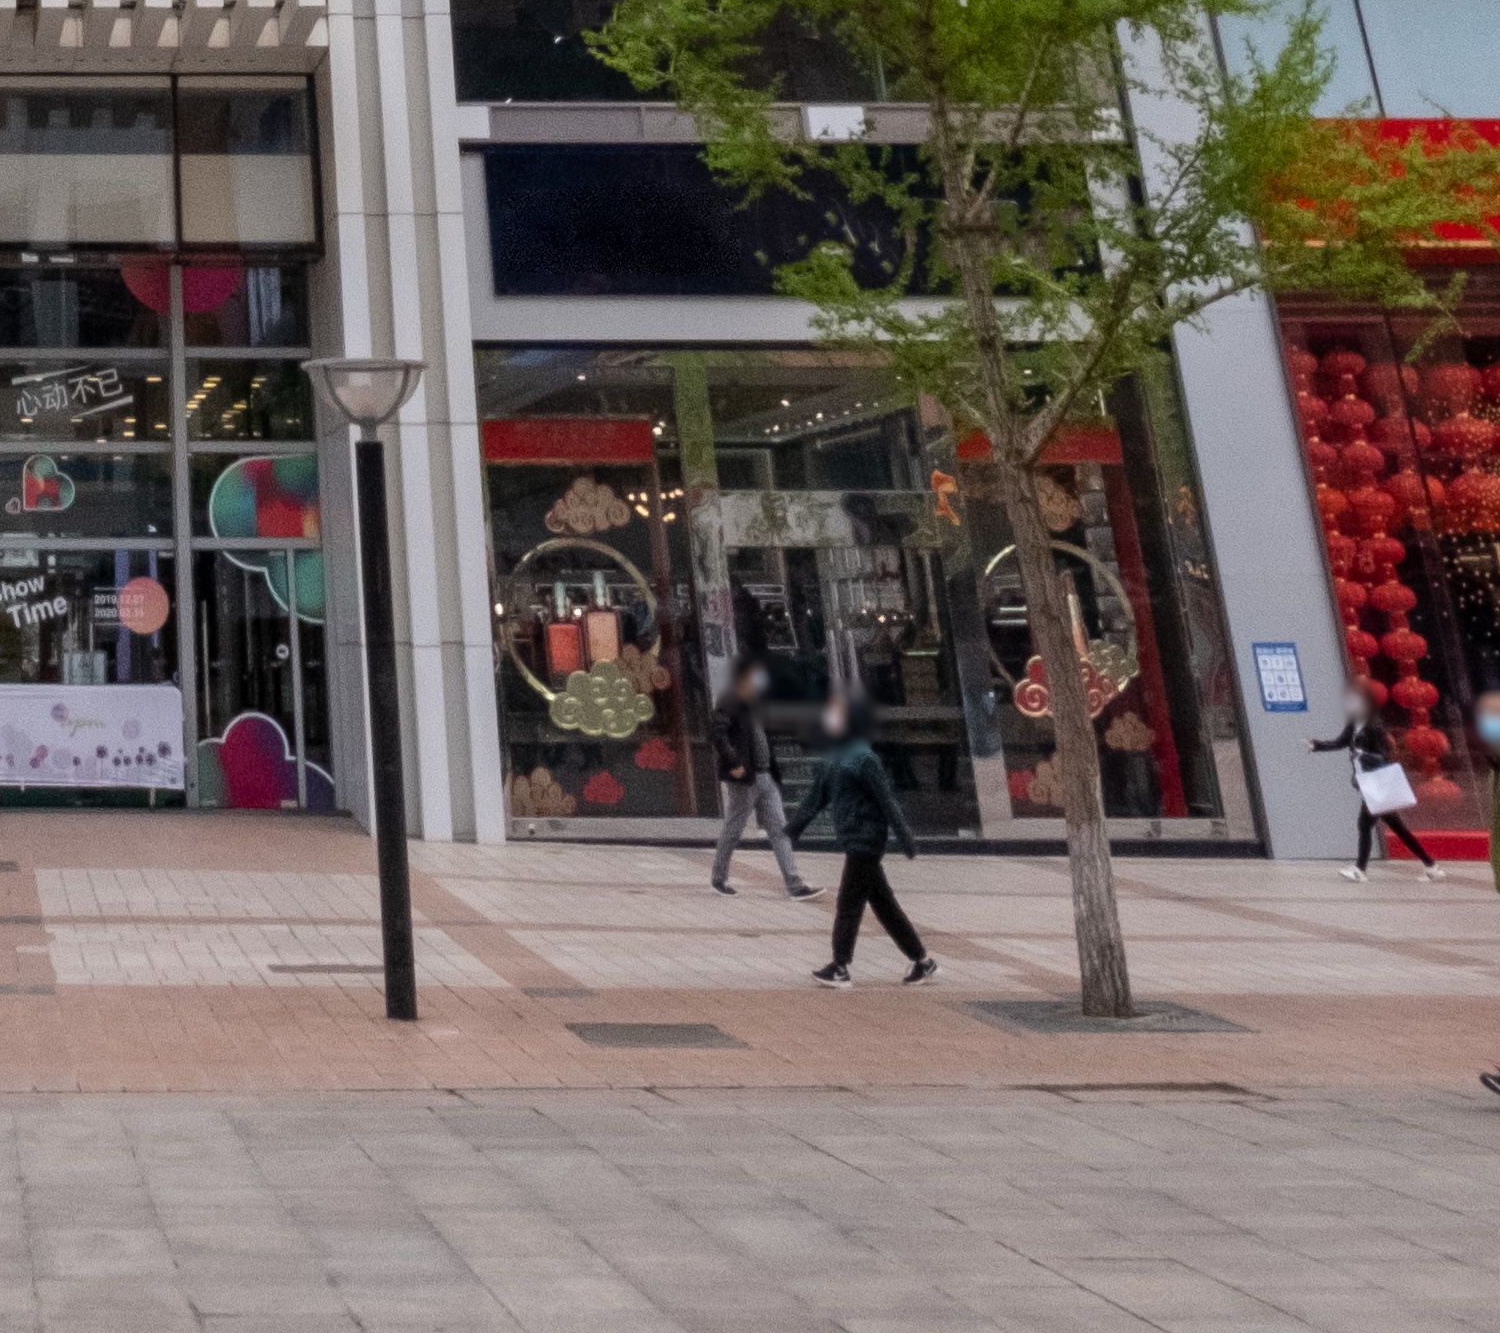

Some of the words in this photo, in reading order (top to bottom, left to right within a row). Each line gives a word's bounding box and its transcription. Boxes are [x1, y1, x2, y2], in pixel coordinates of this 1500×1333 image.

[16, 368, 123, 416] 心动不已
[6, 595, 69, 629] Time
